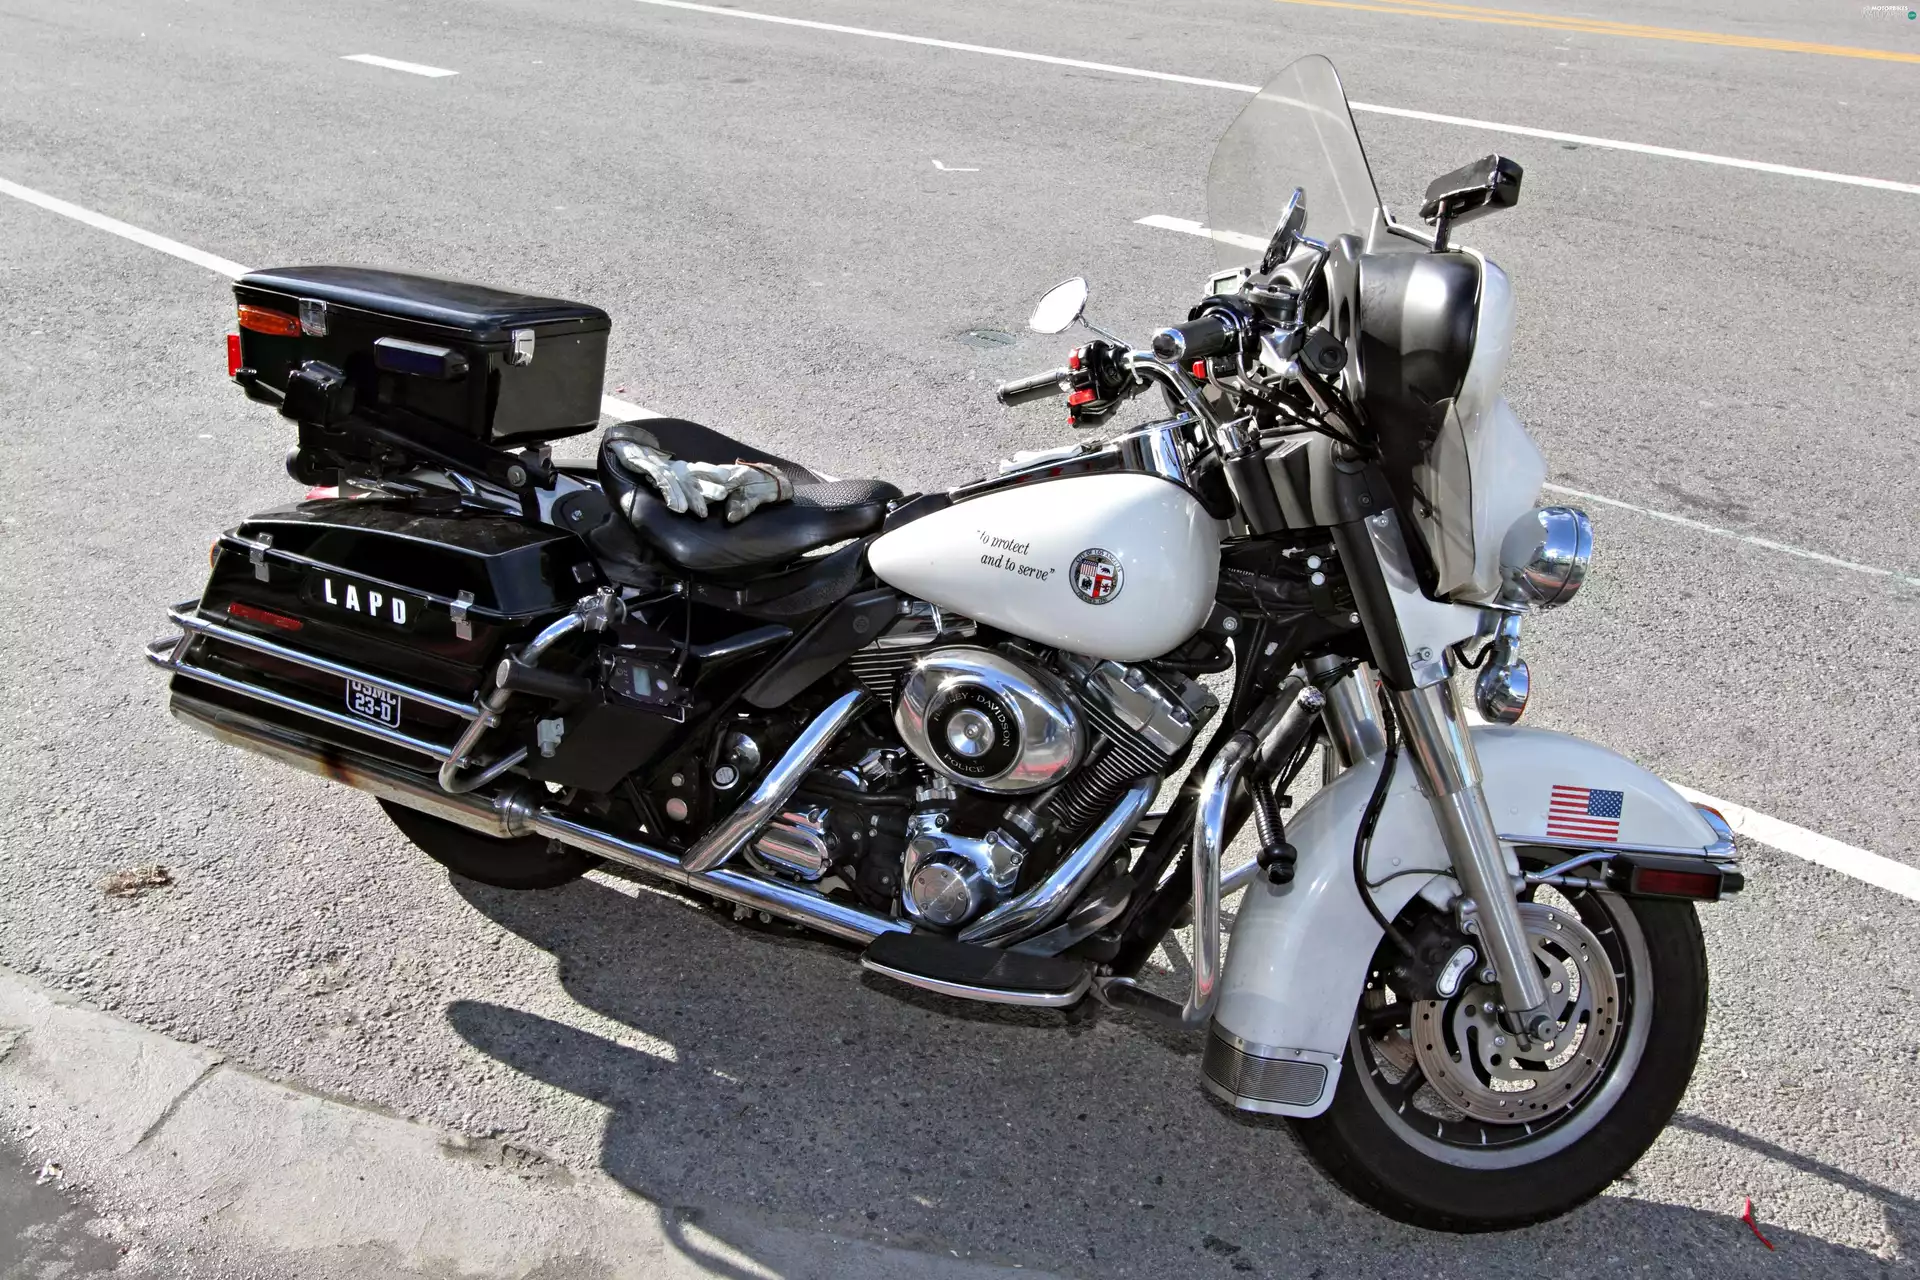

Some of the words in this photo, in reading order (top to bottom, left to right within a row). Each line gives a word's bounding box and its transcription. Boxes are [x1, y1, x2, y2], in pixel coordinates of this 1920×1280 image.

[991, 536, 1030, 556] protect
[980, 554, 1004, 569] and
[1004, 557, 1016, 572] to
[325, 578, 406, 625] LAPD
[355, 692, 391, 721] 23-D
[976, 694, 1011, 747] DAVIDSON
[943, 753, 985, 773] POLICE
